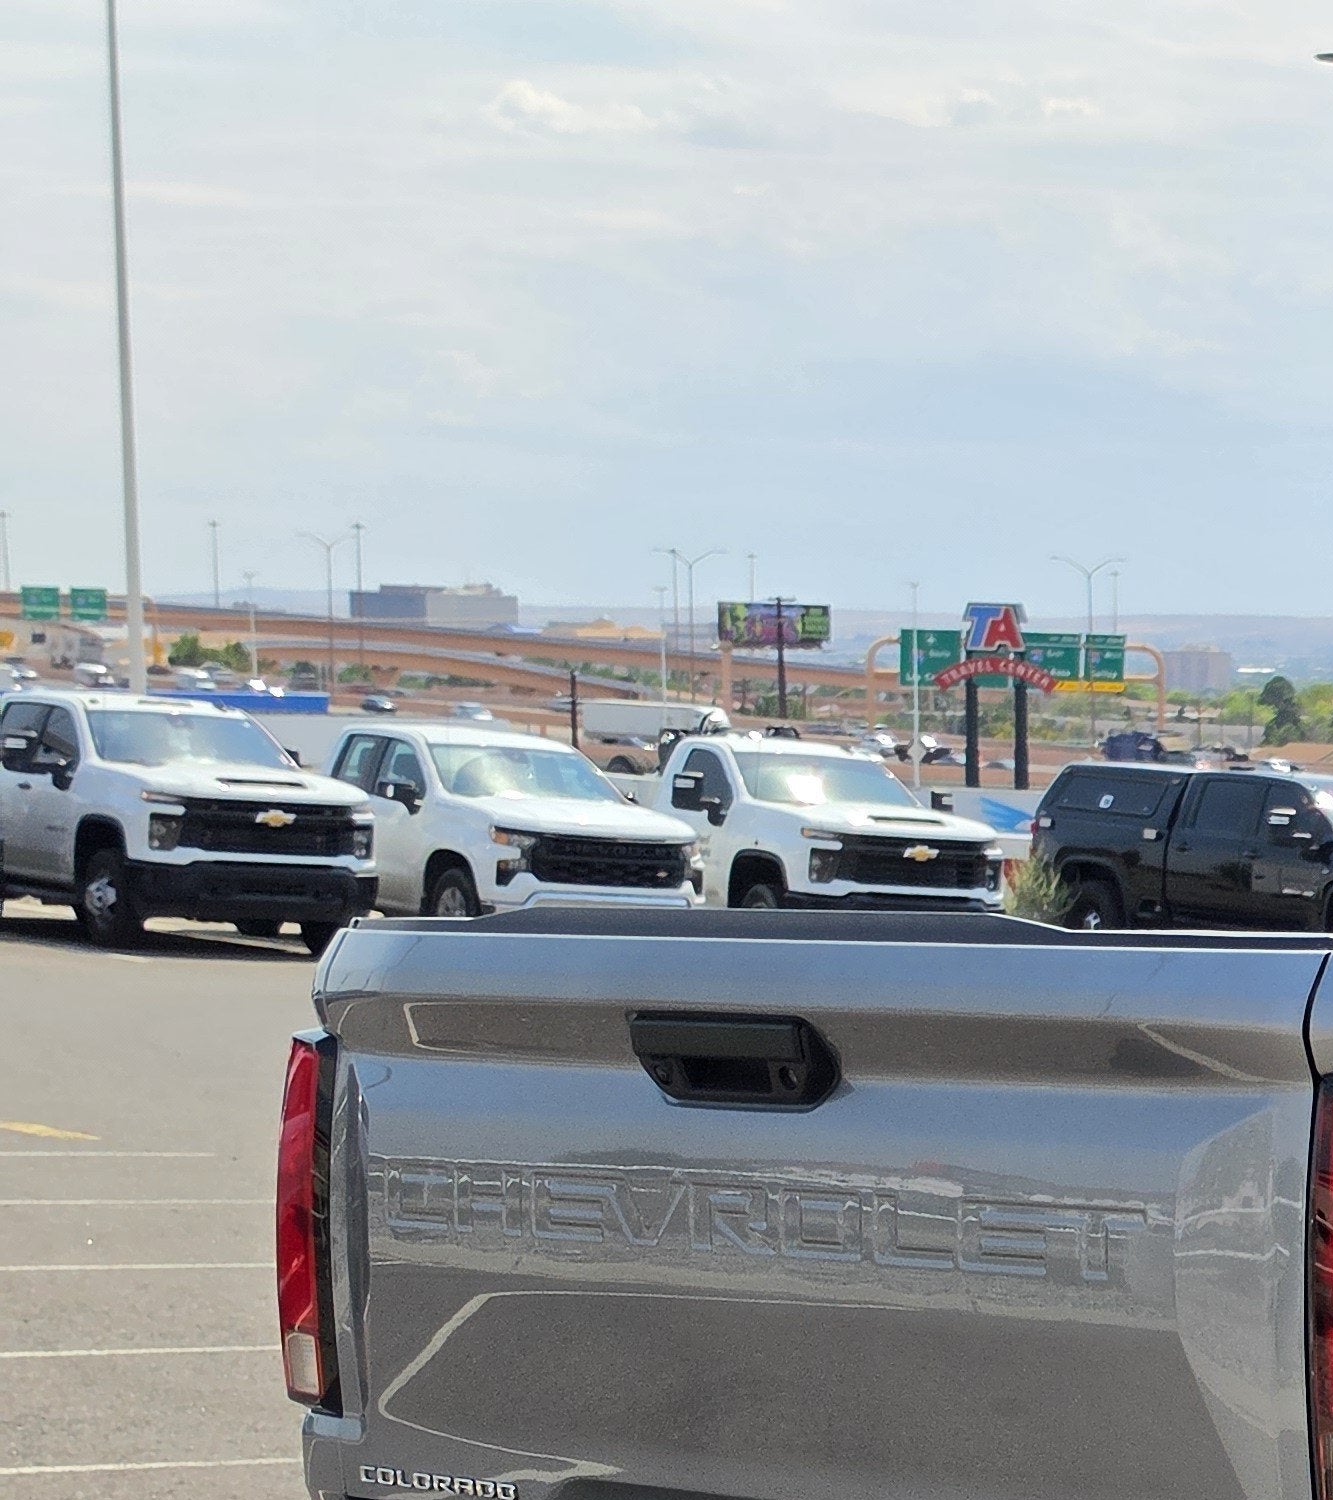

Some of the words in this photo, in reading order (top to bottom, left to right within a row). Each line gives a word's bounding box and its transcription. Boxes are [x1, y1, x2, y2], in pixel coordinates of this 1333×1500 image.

[967, 605, 1025, 651] TA
[941, 660, 994, 683] TRAVEL
[999, 660, 1051, 687] CENTER
[384, 1163, 1146, 1281] CHEVROLET
[359, 1464, 519, 1500] COLORADO
